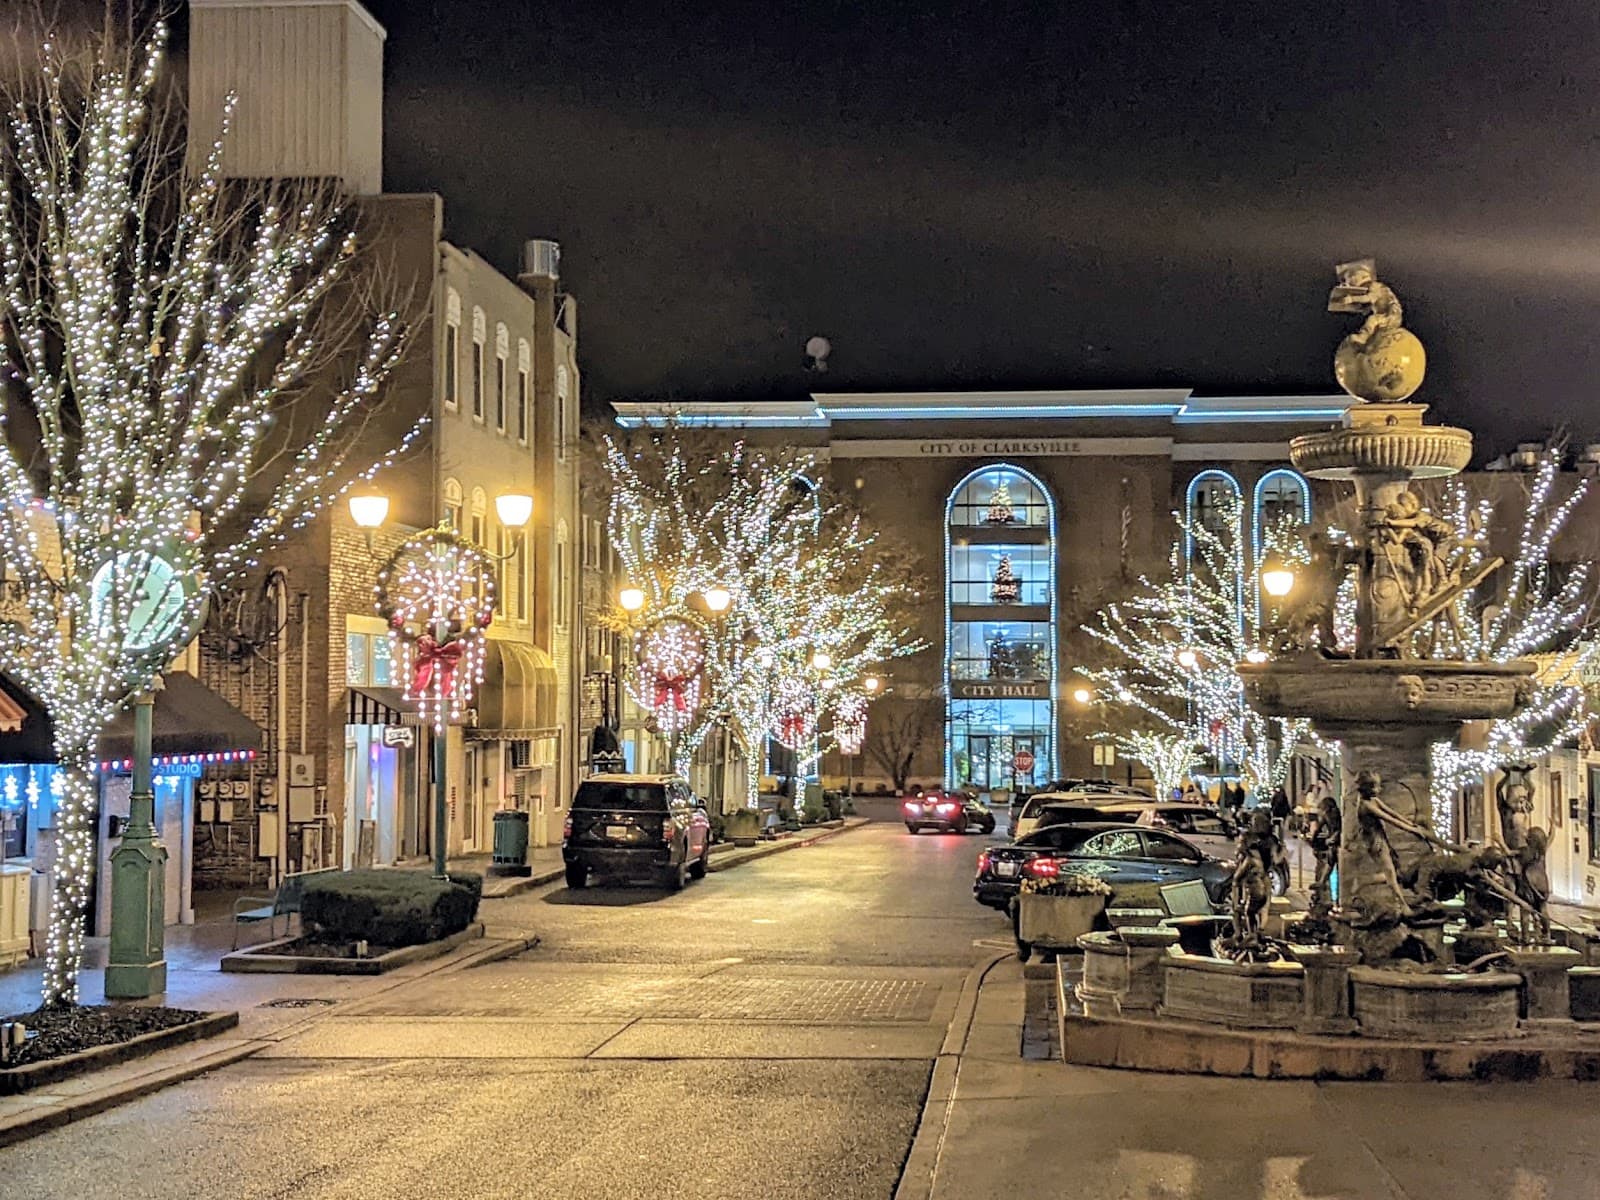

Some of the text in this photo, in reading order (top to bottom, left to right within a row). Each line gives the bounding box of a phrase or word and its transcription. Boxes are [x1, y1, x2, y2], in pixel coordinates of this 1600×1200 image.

[920, 442, 1081, 454] CITY OF CLARKSVILLE
[962, 685, 1039, 696] CITY HALL
[1015, 756, 1032, 766] STOP
[158, 763, 200, 775] STUDIO
